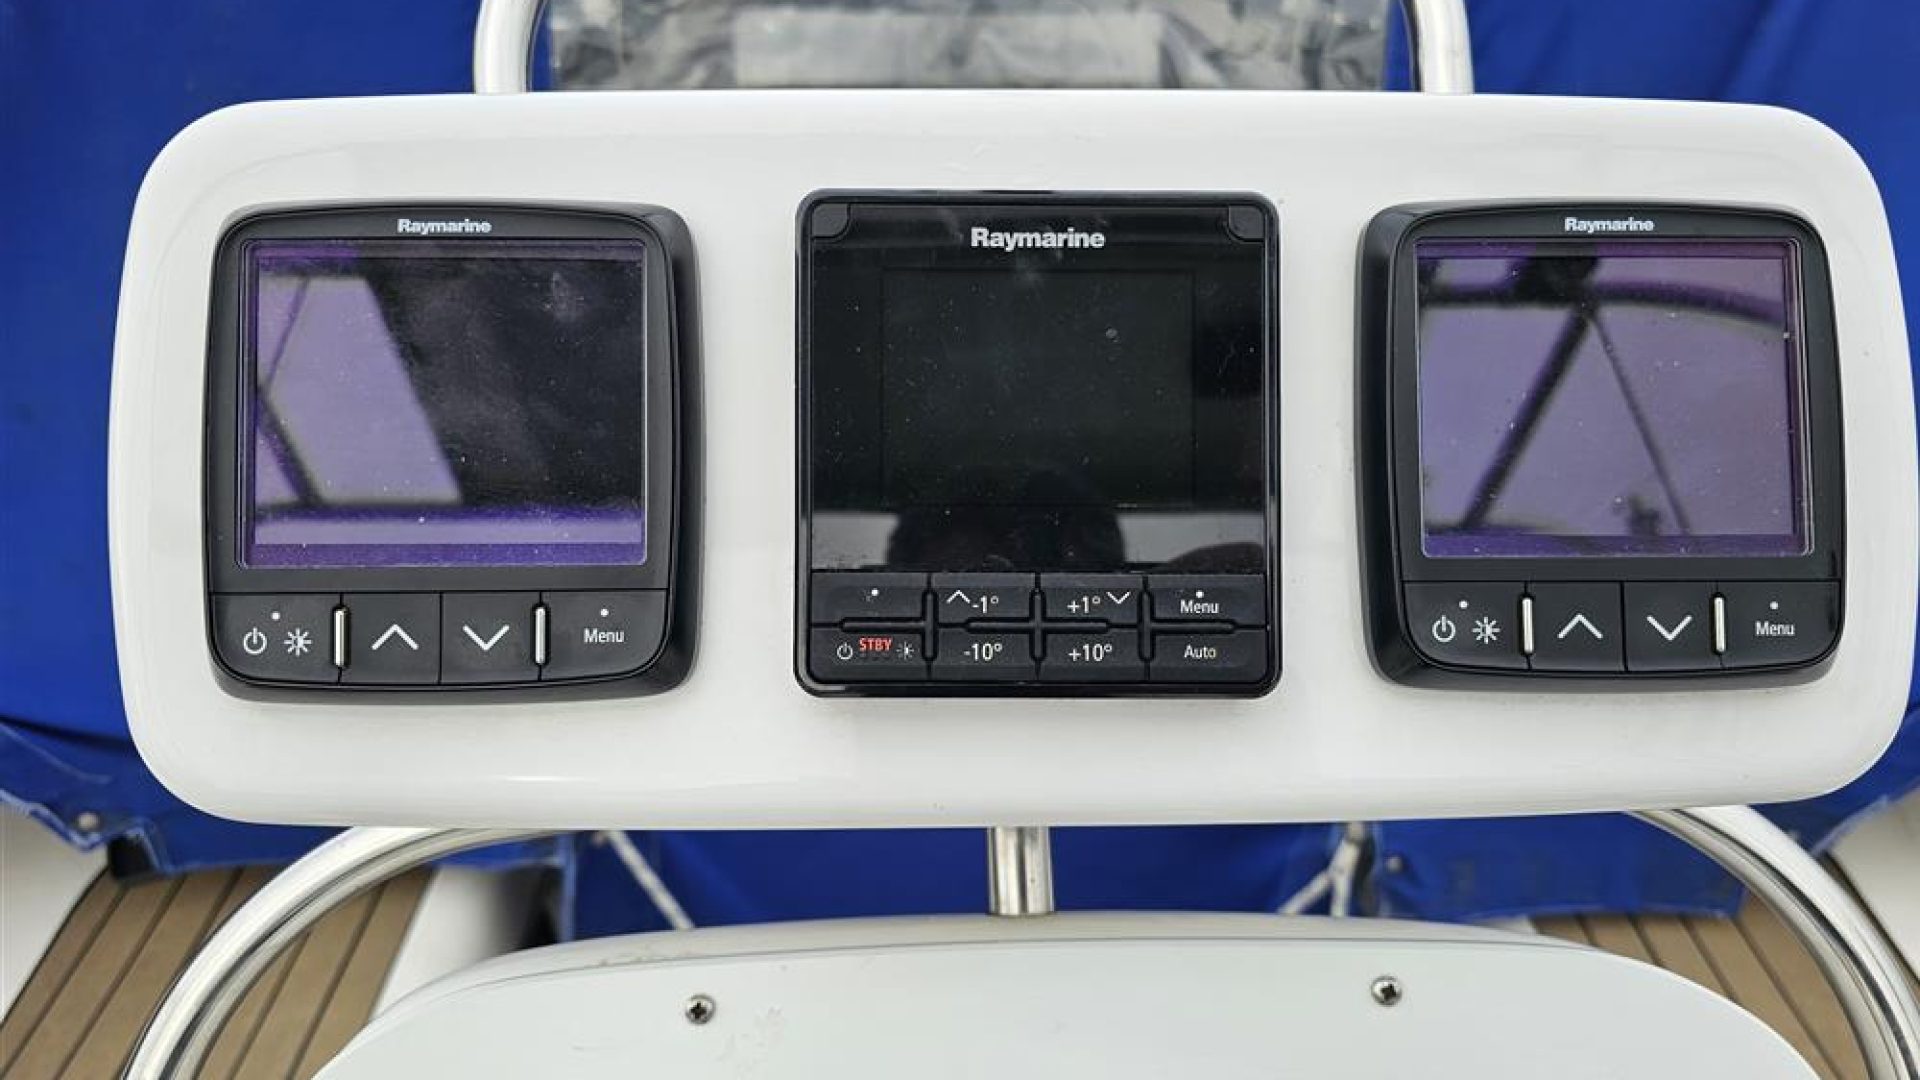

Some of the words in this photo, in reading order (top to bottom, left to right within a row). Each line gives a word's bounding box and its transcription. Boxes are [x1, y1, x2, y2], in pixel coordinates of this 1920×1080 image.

[398, 218, 492, 235] Raymarine
[1564, 217, 1655, 233] Raymarine
[971, 226, 1105, 252] Raymarine
[1180, 599, 1220, 614] Menu
[583, 627, 625, 643] Menu
[1755, 621, 1796, 636] Menu
[858, 637, 893, 652] STBY
[1184, 644, 1217, 659] Auto
